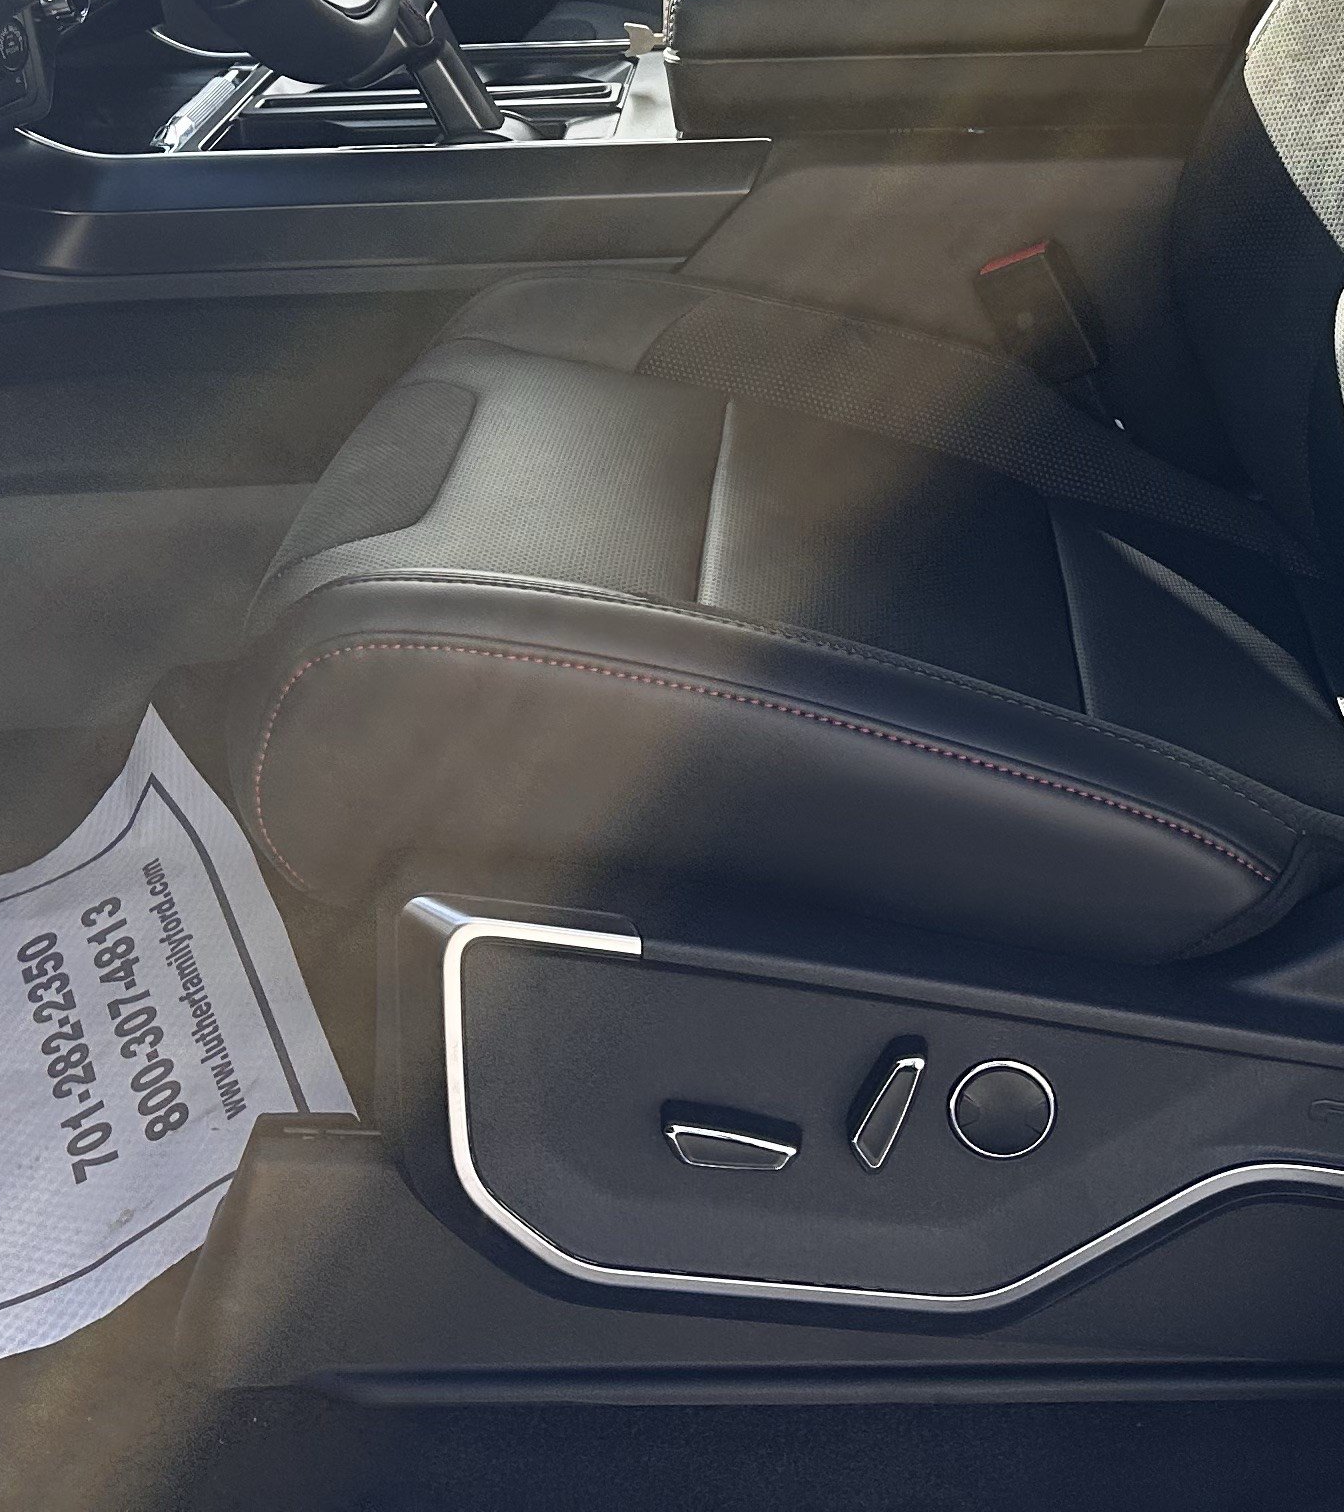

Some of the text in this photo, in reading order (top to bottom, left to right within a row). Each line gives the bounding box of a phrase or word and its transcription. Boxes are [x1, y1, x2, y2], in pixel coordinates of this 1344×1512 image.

[16, 931, 120, 1185] 701-282-2350
[80, 896, 190, 1142] 800-307-4813
[141, 857, 247, 1121] www.lutherfamilyford.com
